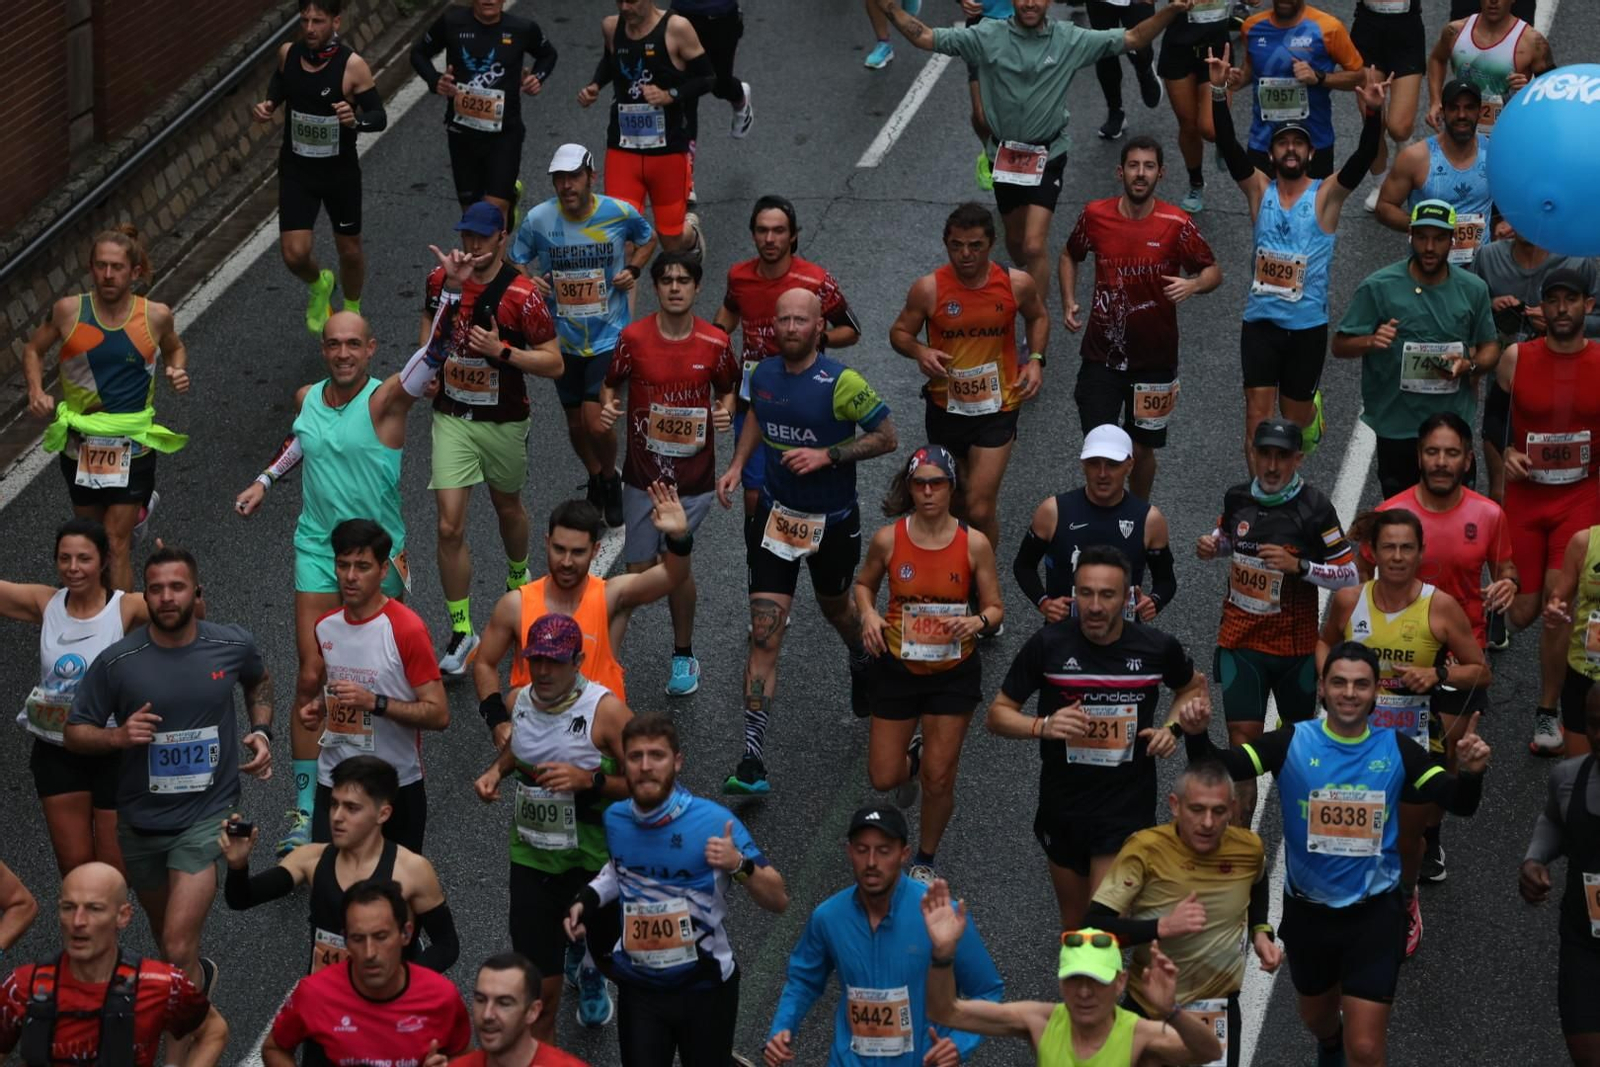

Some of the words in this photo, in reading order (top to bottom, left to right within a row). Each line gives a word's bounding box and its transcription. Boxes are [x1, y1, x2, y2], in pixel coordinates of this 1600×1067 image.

[462, 95, 492, 113] 6232
[1265, 89, 1296, 102] 7957
[297, 123, 328, 140] 6968
[1261, 260, 1293, 280] 4829
[560, 282, 594, 299] 3877
[451, 367, 485, 386] 4142
[953, 377, 987, 397] 6354
[656, 418, 693, 436] 4328
[766, 421, 818, 442] BEKA
[1541, 447, 1571, 461] 646
[776, 517, 809, 540] 5849
[1234, 568, 1267, 591] 5049
[1374, 647, 1415, 663] ORRE
[339, 671, 376, 685] SEVILLA
[35, 704, 67, 724] 773
[1373, 709, 1416, 729] 2949
[1081, 721, 1119, 740] 231
[158, 745, 204, 767] 3012
[521, 802, 558, 824] 6909
[1320, 805, 1367, 828] 6338
[632, 918, 674, 941] 3740
[851, 1004, 894, 1027] 5442
